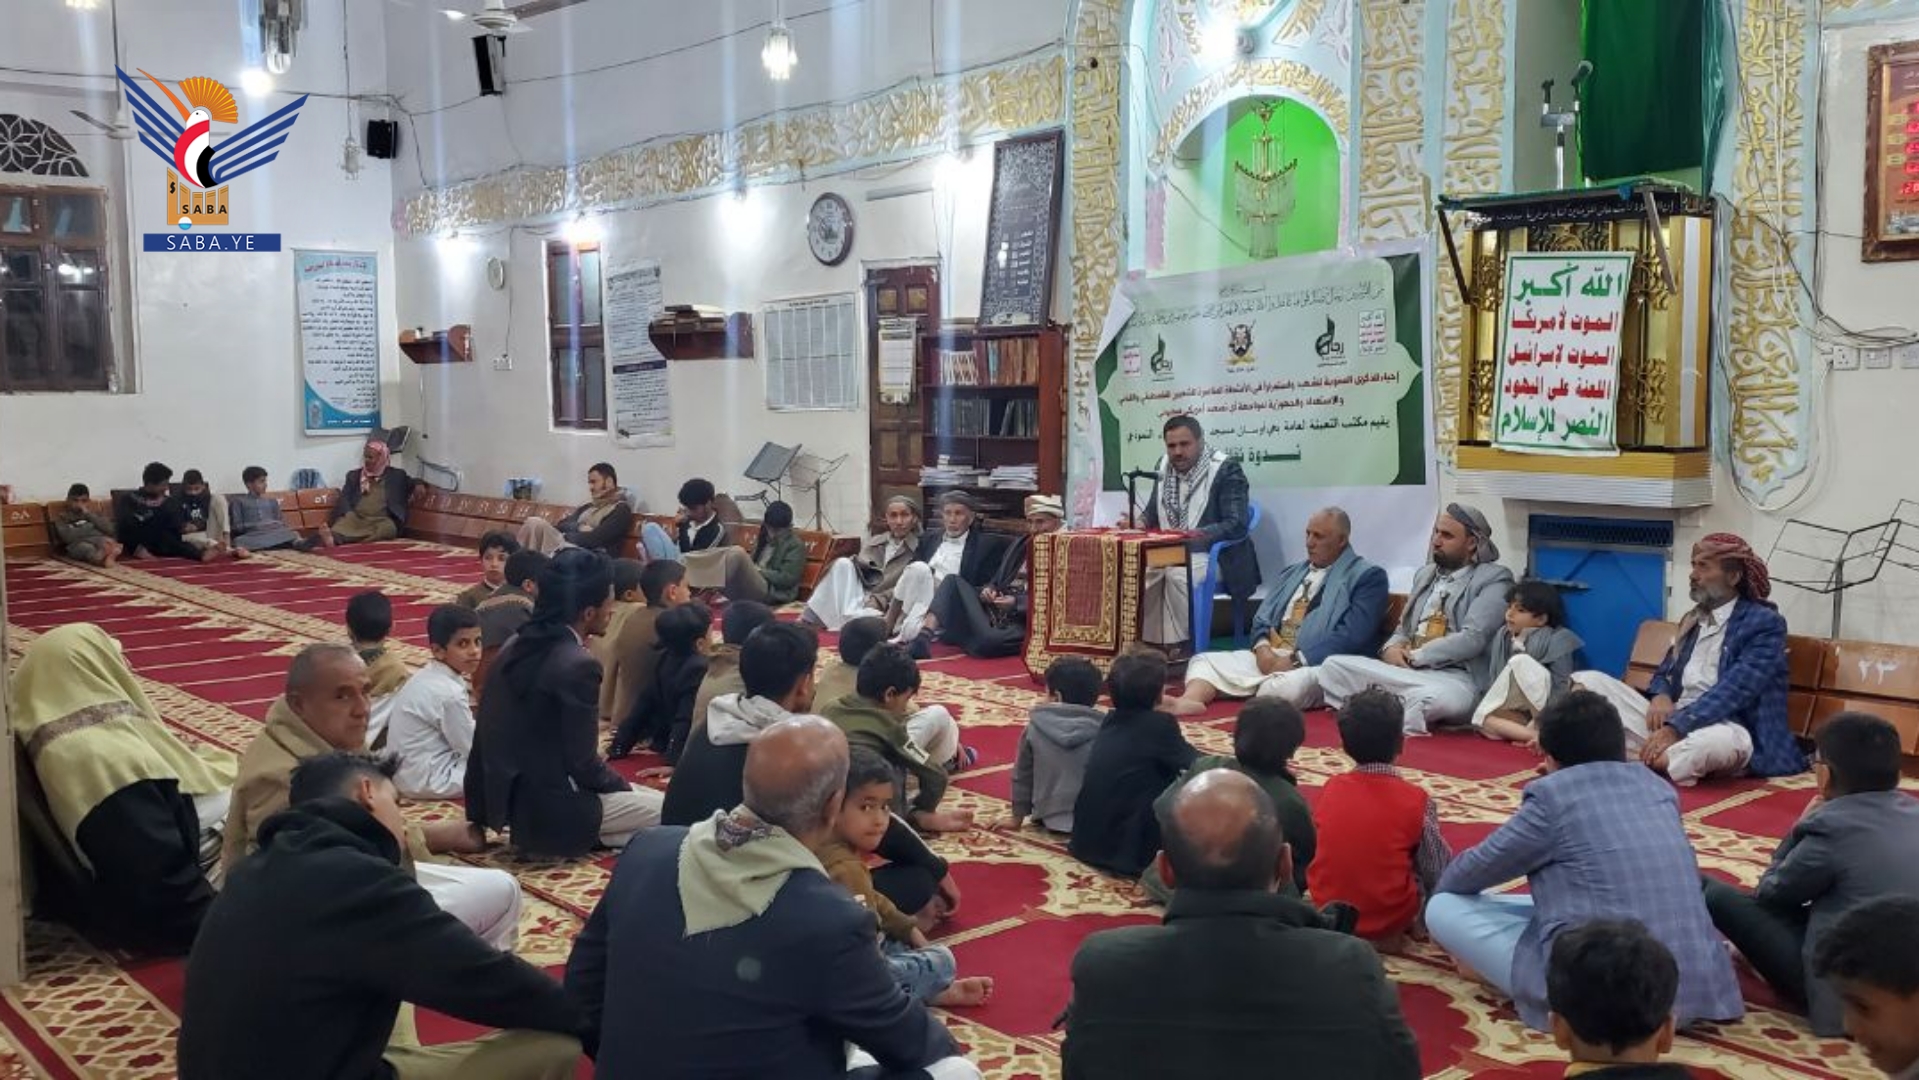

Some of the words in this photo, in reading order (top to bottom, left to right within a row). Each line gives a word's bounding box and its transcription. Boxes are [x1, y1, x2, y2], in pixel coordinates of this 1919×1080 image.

[1580, 264, 1623, 298] الله
[1571, 310, 1619, 336] الموت
[1507, 341, 1564, 369] لإسرائيل
[1567, 345, 1615, 369] الموت
[1504, 375, 1544, 399] اليهود
[1548, 377, 1569, 401] على
[1576, 377, 1612, 400] اللعنة
[1342, 416, 1368, 429] مكتب
[1370, 415, 1391, 432] يقيم
[1501, 404, 1556, 442] للإسلام
[1560, 405, 1610, 441] النصر
[1249, 443, 1302, 467] ندوة
